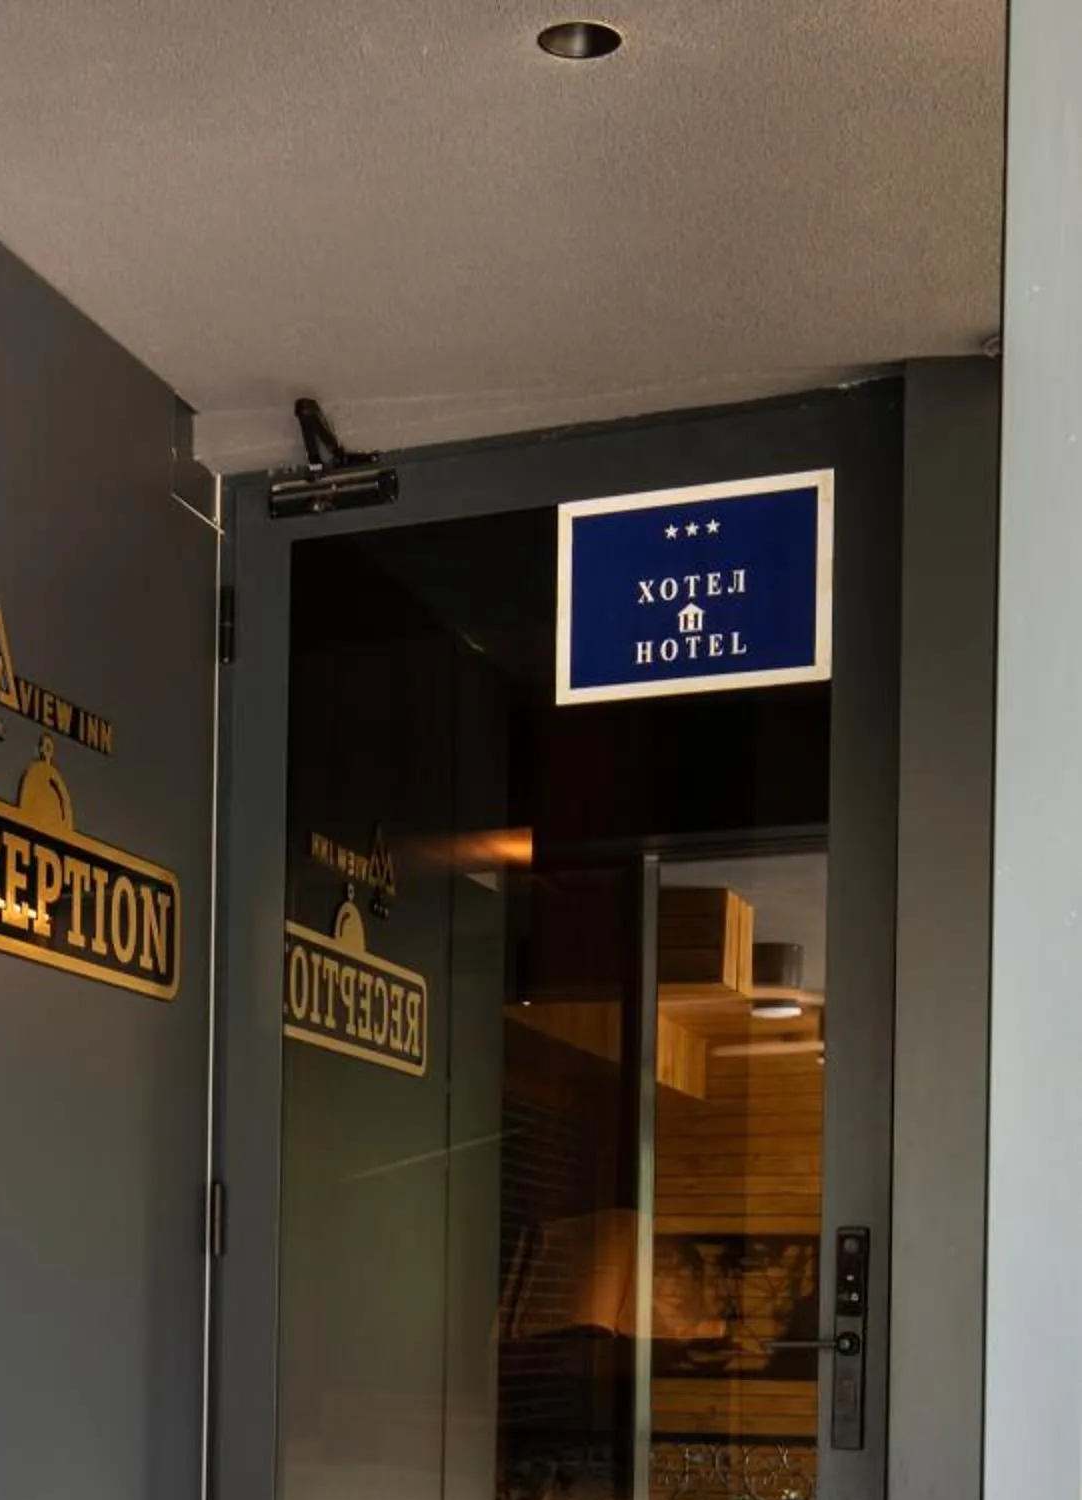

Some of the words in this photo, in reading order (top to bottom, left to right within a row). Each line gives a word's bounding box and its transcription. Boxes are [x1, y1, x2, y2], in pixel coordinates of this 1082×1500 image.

[637, 569, 747, 604] ХОТЕЛ
[635, 632, 748, 665] HOTEL
[18, 679, 74, 735] VIEW
[78, 710, 113, 755] INN
